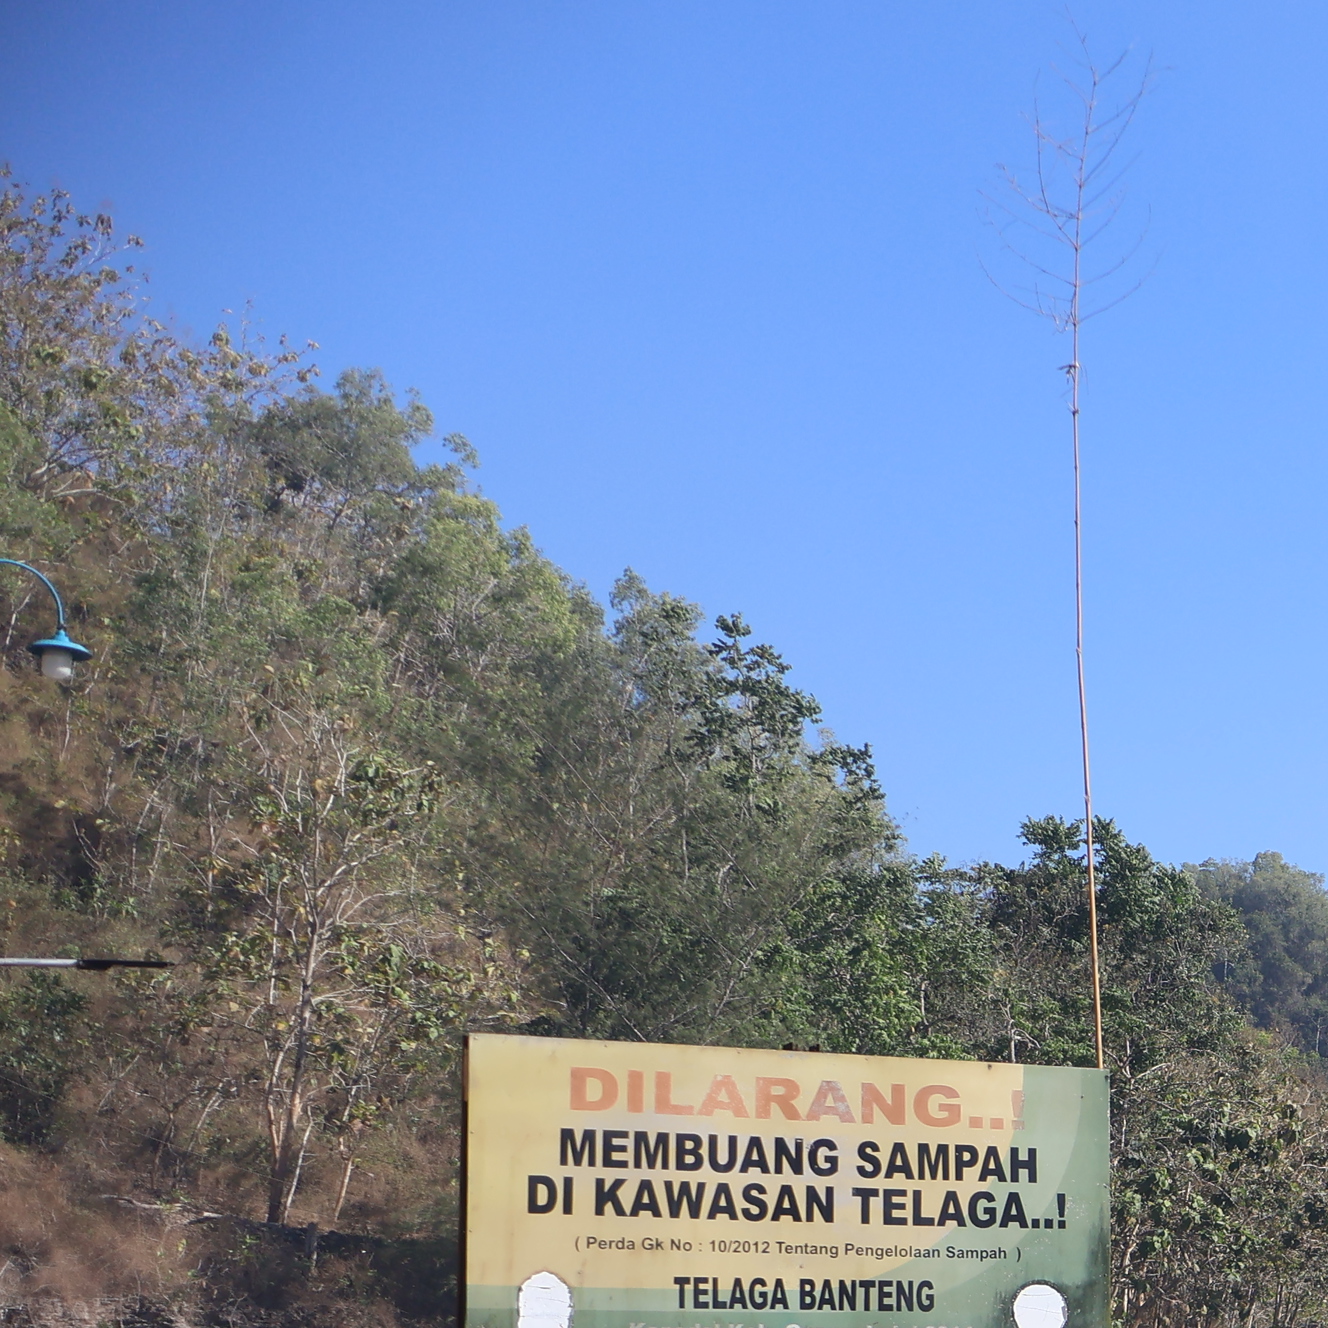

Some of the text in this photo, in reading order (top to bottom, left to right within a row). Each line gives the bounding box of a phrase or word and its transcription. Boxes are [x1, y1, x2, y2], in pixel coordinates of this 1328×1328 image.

[570, 1066, 1025, 1131] DILARANG..!
[559, 1127, 1038, 1184] MEMBUANG SAMPAH
[527, 1174, 1067, 1230] DI KAWASAN TELAGA..!
[586, 1236, 636, 1251] Perda
[641, 1237, 665, 1251] Gk
[670, 1238, 693, 1252] No
[708, 1239, 771, 1254] 10/2012
[775, 1241, 840, 1258] Tentang
[843, 1242, 941, 1260] Pengelolaan
[945, 1245, 1007, 1263] Sampah
[673, 1276, 935, 1313] TELAGA BANTENG
